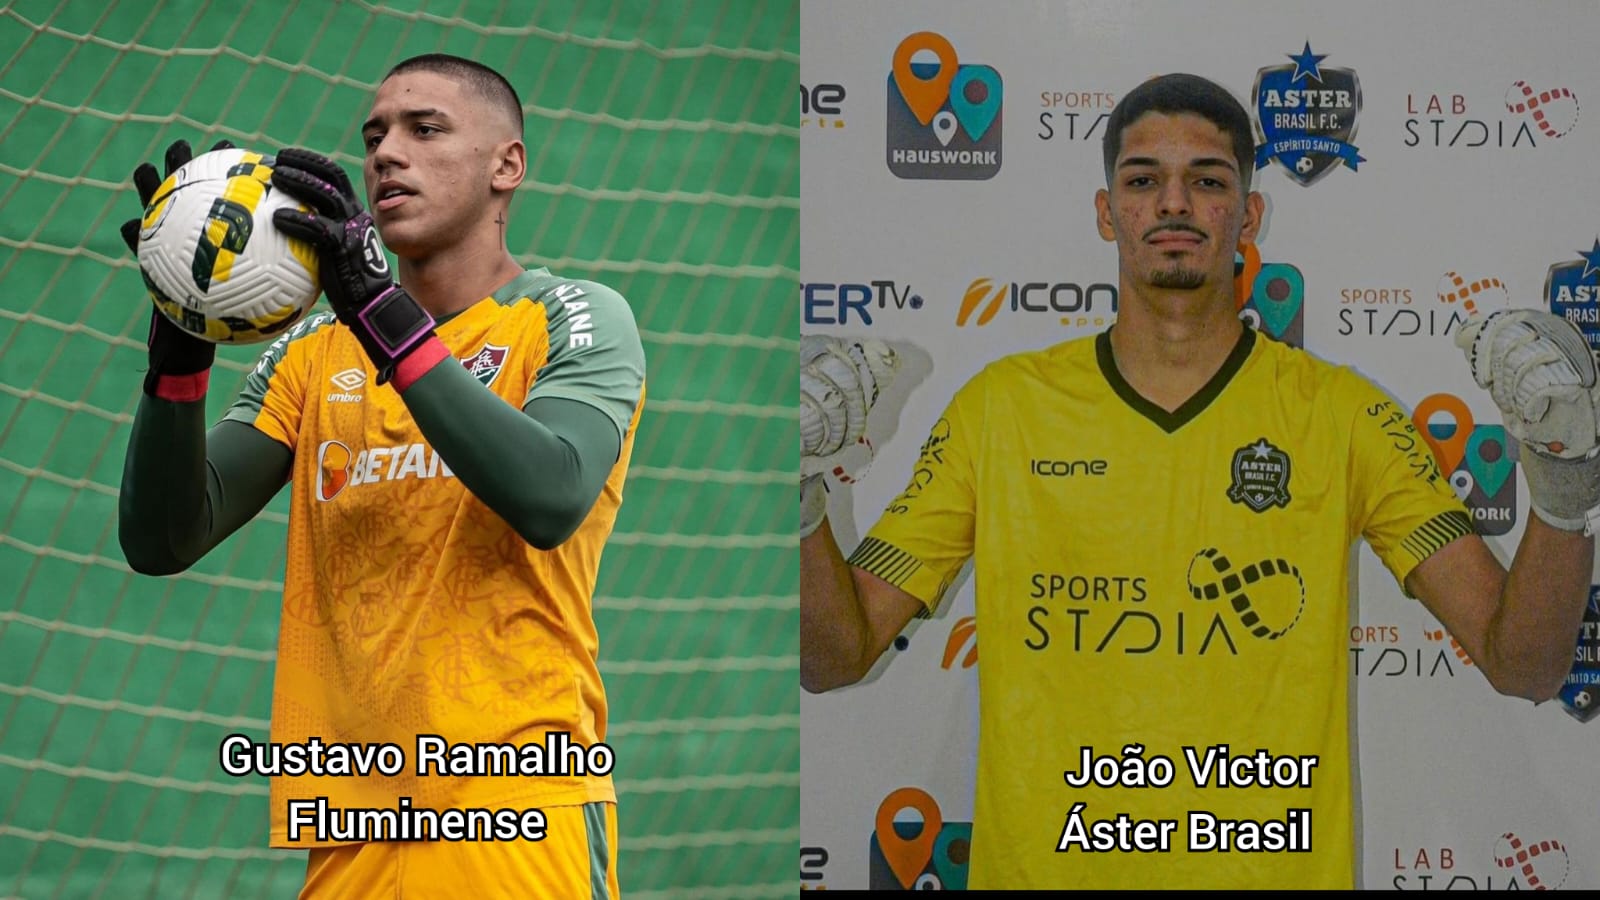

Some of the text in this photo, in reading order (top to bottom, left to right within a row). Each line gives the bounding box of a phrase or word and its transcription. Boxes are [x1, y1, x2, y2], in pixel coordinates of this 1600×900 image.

[1041, 91, 1115, 109] SPORTS
[1407, 94, 1466, 114] LAB
[1274, 113, 1341, 129] BRASIL F.C.
[1312, 139, 1341, 154] SANTO
[1341, 288, 1413, 304] SPORTS
[327, 391, 362, 403] umbro
[349, 442, 457, 487] BETAN
[1030, 573, 1147, 603] SPORTS
[1350, 626, 1399, 643] ORTS
[1349, 648, 1454, 677] TADIA
[1394, 847, 1455, 870] LAB
